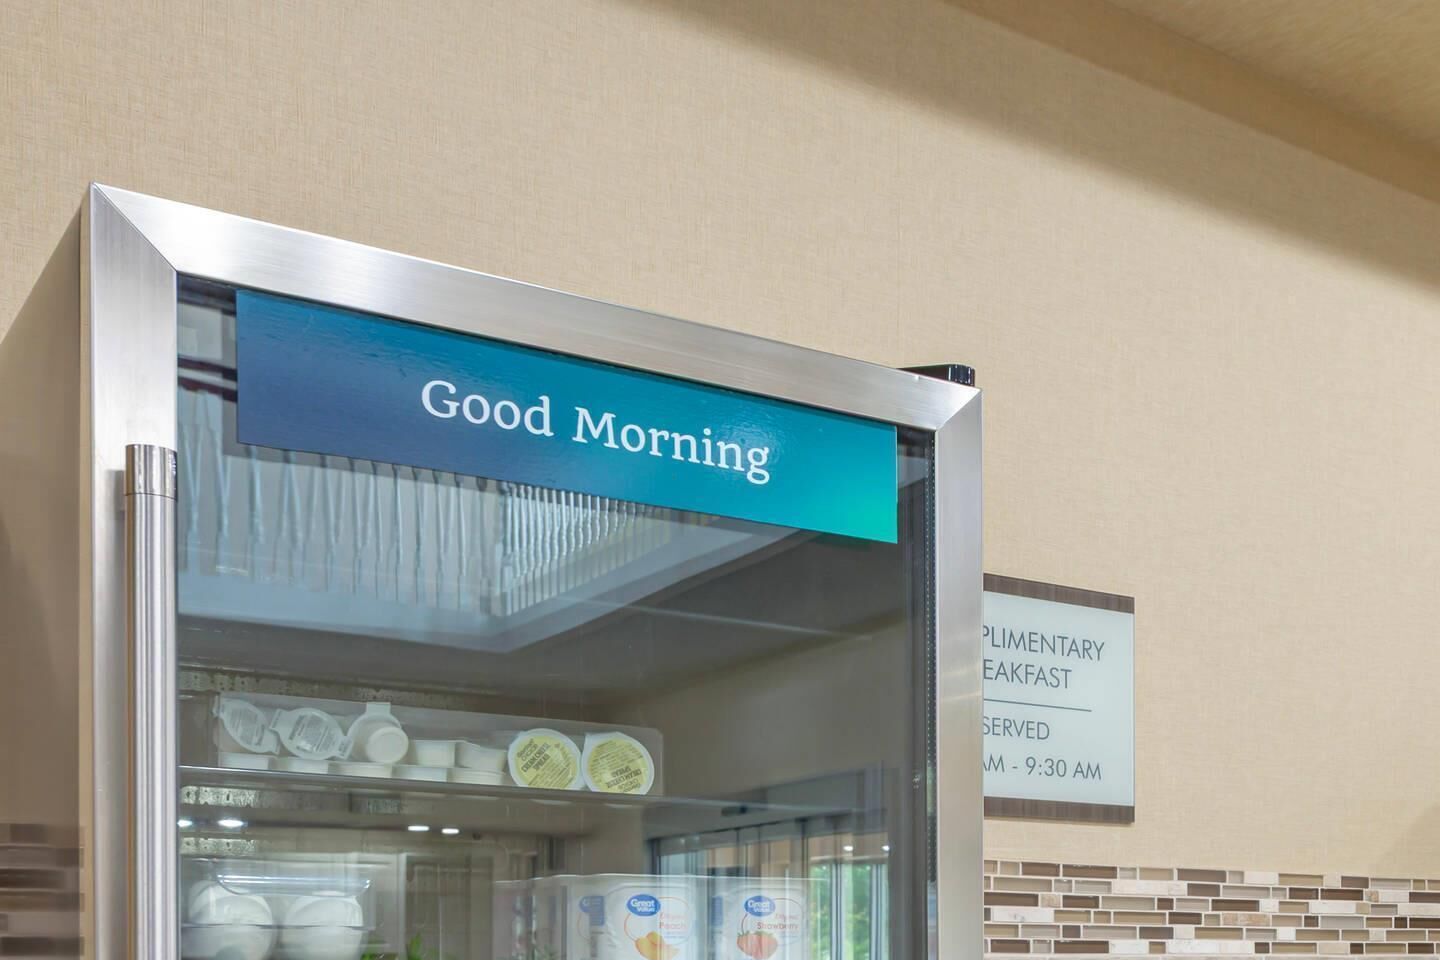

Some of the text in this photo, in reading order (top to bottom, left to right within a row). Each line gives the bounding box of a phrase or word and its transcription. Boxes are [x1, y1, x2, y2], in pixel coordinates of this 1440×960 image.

[421, 380, 770, 485] Good Morning
[983, 658, 1072, 689] EAKFAST
[983, 716, 1050, 740] SERVED
[1026, 756, 1067, 777] 9:30
[1073, 761, 1102, 780] AM
[631, 899, 655, 907] Great
